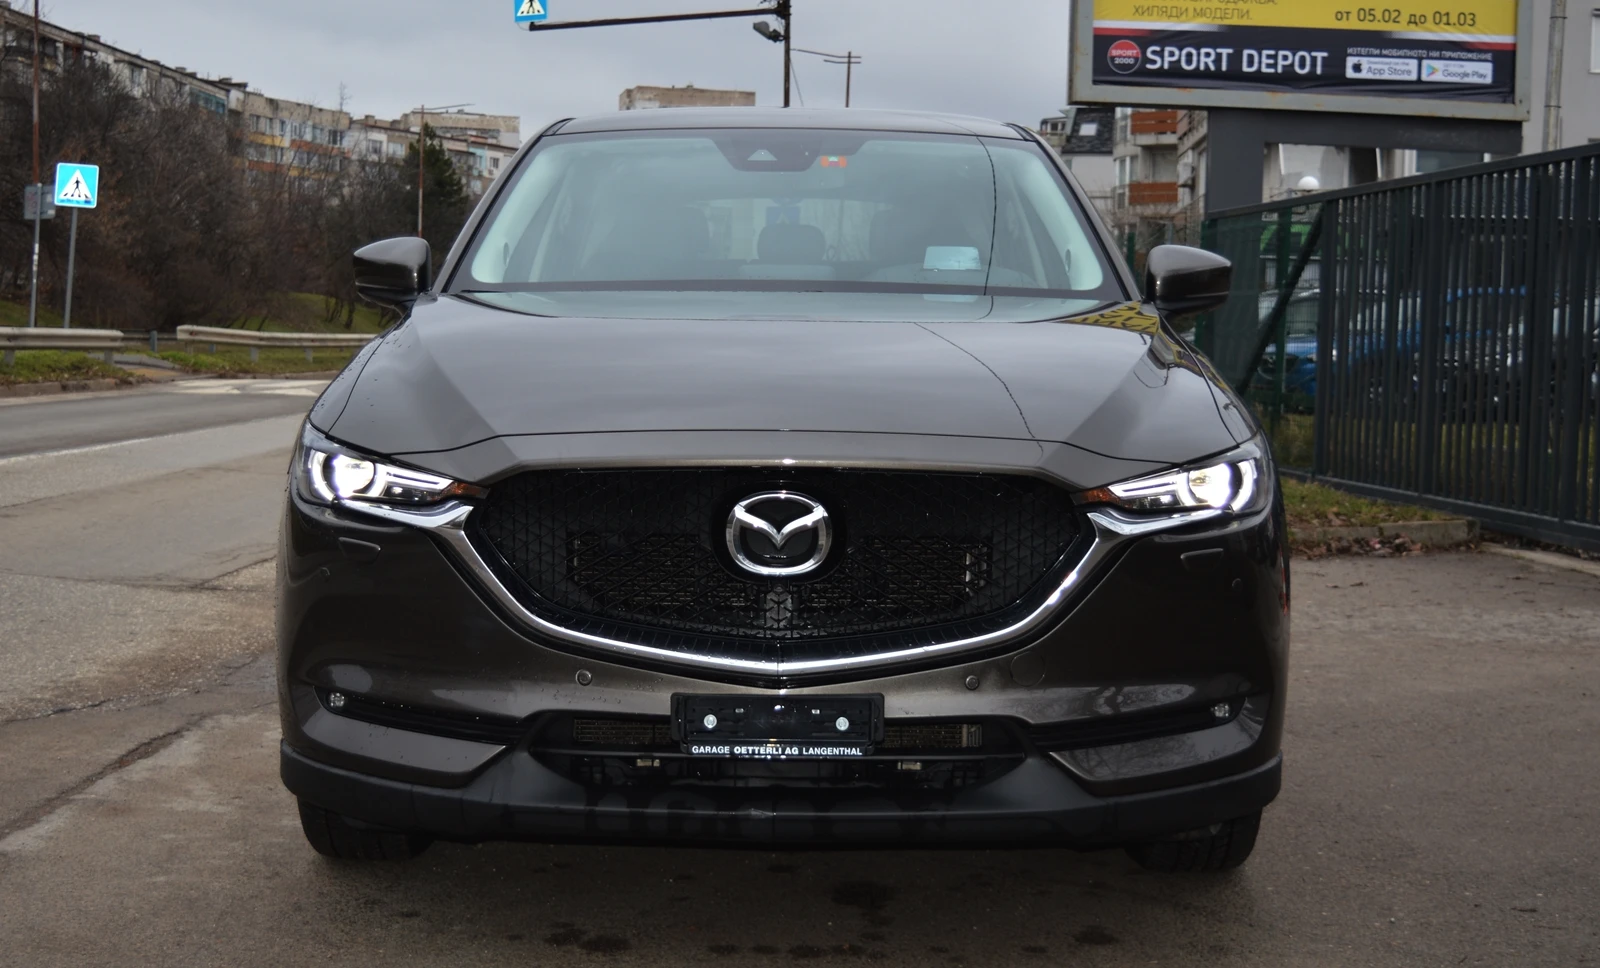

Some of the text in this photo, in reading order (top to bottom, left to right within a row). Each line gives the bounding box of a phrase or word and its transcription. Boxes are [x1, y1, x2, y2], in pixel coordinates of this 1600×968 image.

[1132, 5, 1252, 20] ХИЛЯДИ МОДЕЛИ.
[1335, 8, 1477, 27] от 05.02 до 01.03
[1111, 49, 1137, 57] SPORT
[1347, 47, 1380, 55] ИЗТЕГЛИ
[1429, 50, 1440, 58] НИ
[1145, 46, 1328, 75] SPORT DEPOT
[1366, 66, 1412, 76] App Store
[1442, 69, 1488, 80] Google Play
[692, 745, 863, 756] GARAGE OETTERLI AG LANGENTHAL
